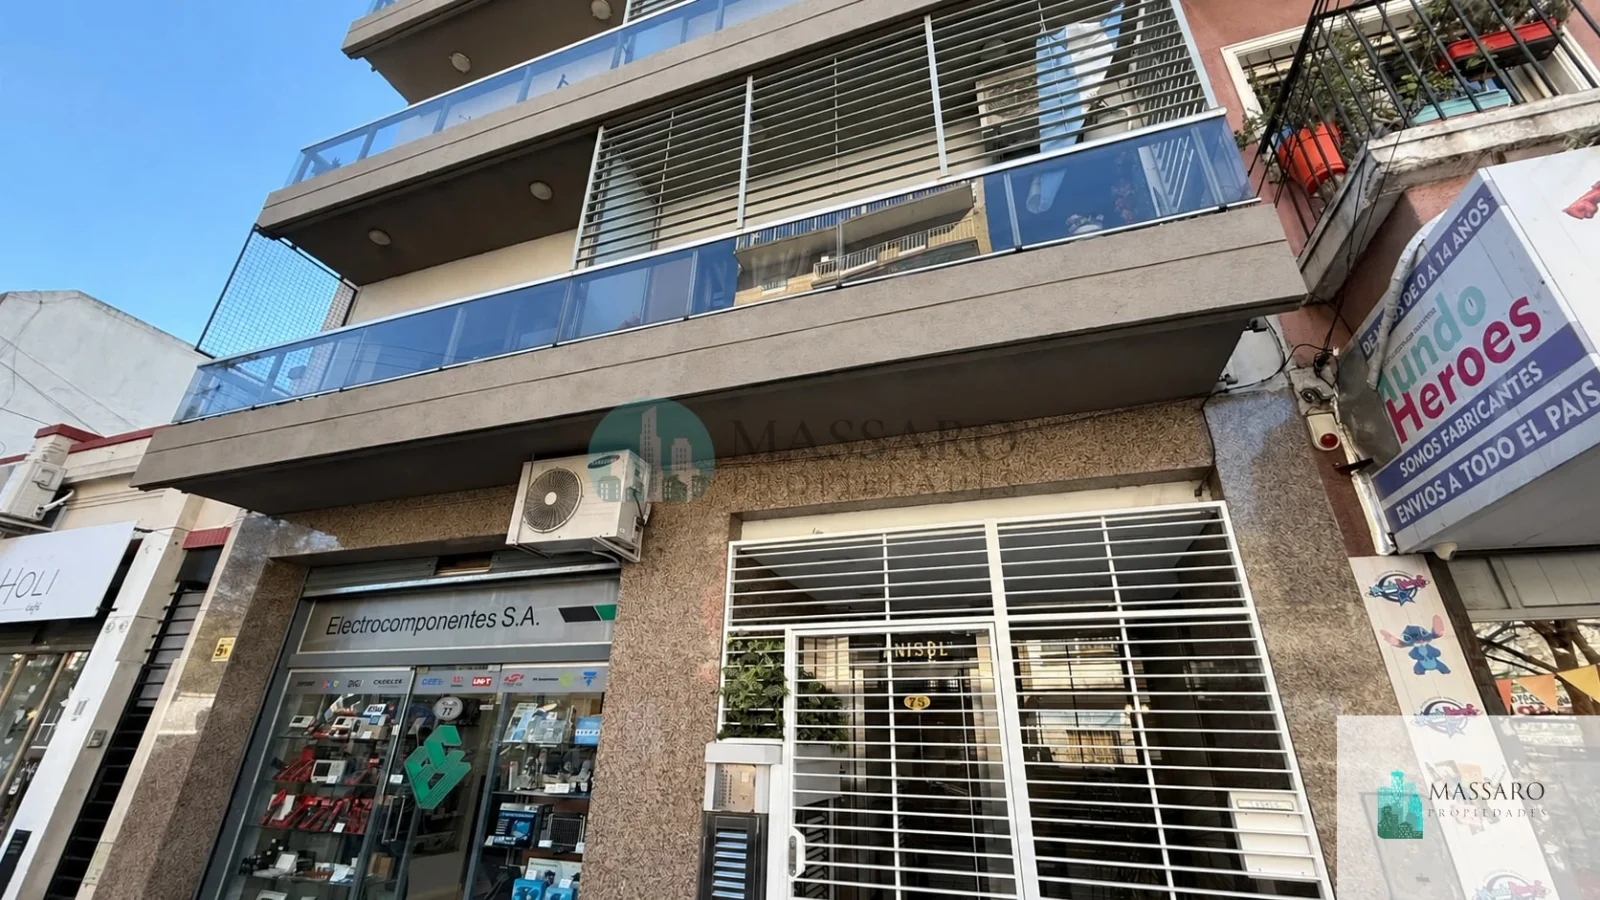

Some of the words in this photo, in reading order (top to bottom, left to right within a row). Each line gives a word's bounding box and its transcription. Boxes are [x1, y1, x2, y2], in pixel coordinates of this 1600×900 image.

[1402, 283, 1420, 307] DE
[1427, 264, 1438, 281] A
[1435, 242, 1453, 267] 14
[1451, 197, 1491, 250] AÑOS
[1385, 295, 1542, 445] Heroes
[1395, 479, 1447, 524] ENVIOS
[1450, 472, 1463, 494] A
[1458, 436, 1516, 483] TODO
[1515, 418, 1548, 449] EL
[1544, 379, 1600, 431] PAIS
[1399, 436, 1442, 478] SOMOS
[1440, 360, 1544, 447] FABRICANTES
[0, 567, 60, 605] HOLI
[325, 609, 497, 636] Electrocomponentes
[501, 605, 540, 628] S.A.
[442, 707, 453, 716] 77
[908, 696, 926, 708] 75
